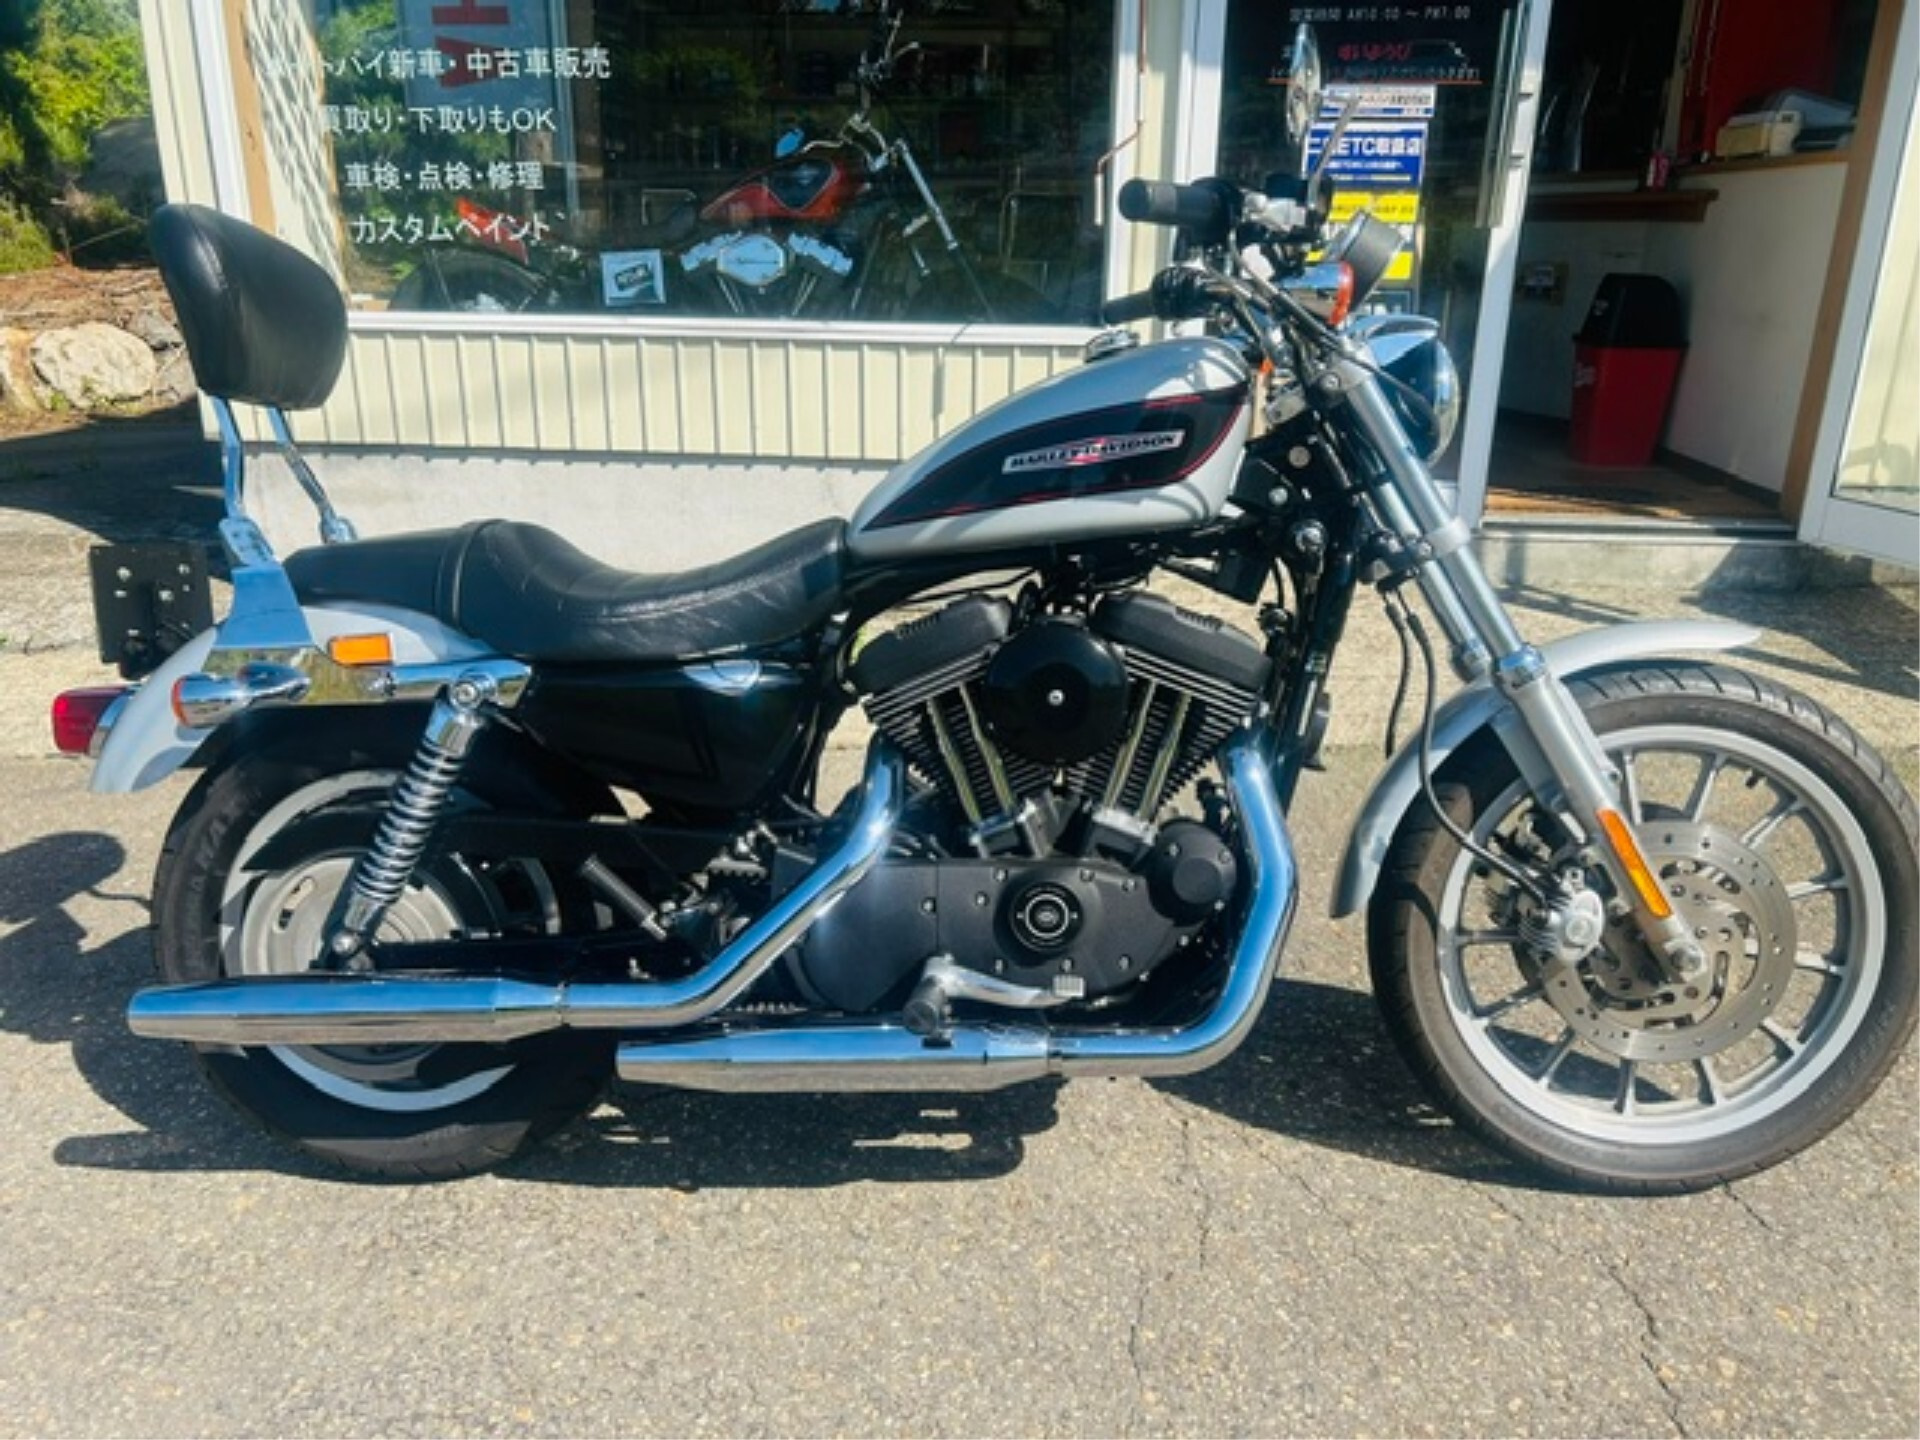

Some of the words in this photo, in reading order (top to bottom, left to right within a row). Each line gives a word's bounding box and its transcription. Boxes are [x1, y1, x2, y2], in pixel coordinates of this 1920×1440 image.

[345, 162, 545, 191] 車検・点検・修理
[351, 212, 551, 244] カスタムペイント
